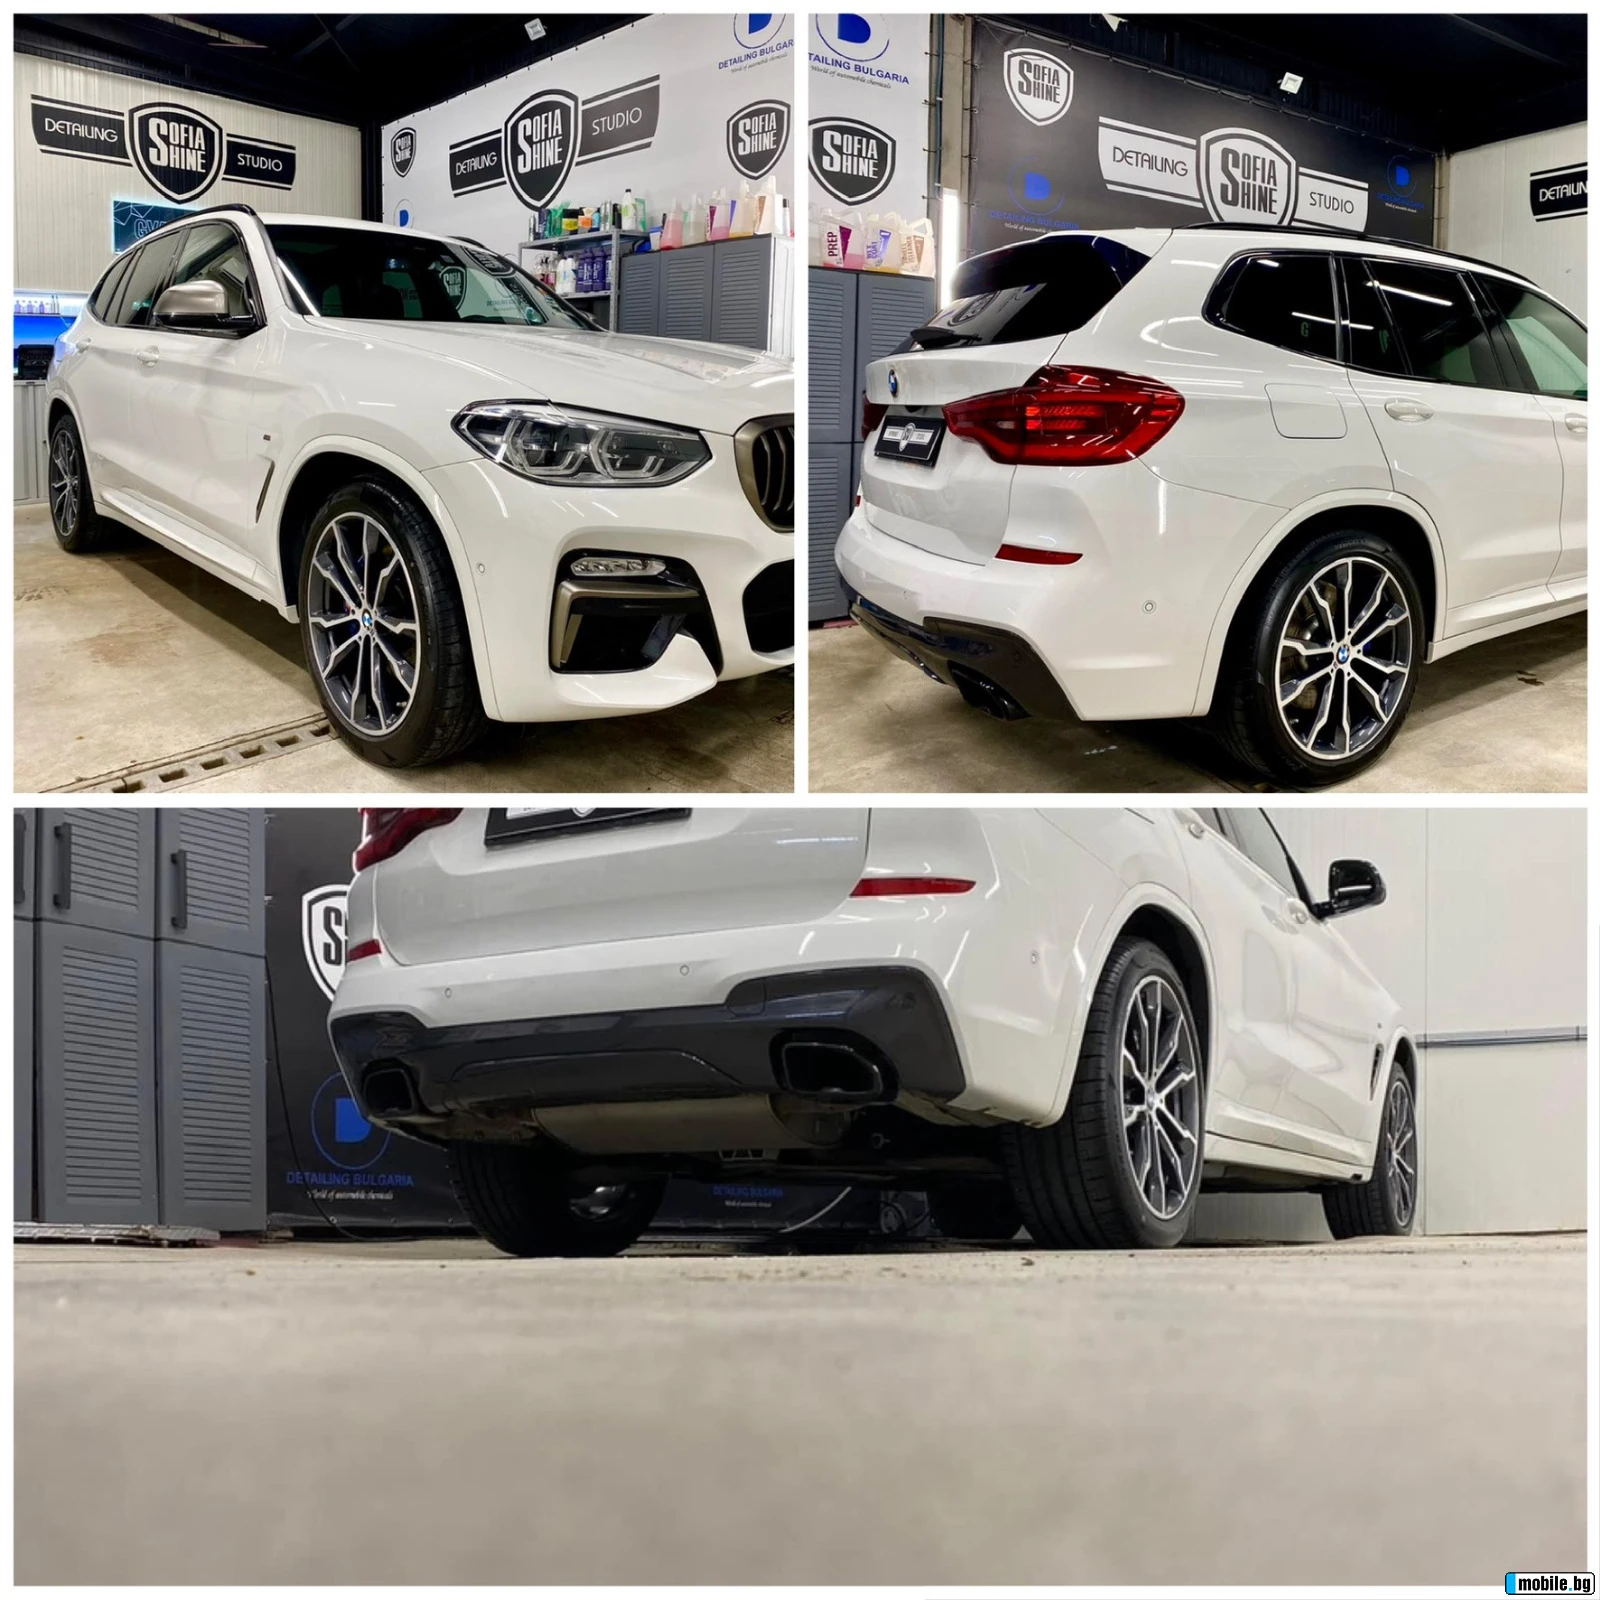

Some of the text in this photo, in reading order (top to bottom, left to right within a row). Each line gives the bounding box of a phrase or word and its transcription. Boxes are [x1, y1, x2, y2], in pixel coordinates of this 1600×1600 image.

[718, 51, 758, 70] DETAILING
[808, 52, 910, 84] TAILING BULGARIA
[1018, 59, 1060, 86] SOFIA
[45, 118, 118, 143] DETAILING
[149, 117, 205, 150] SOFIA
[517, 109, 562, 143] SOFIA
[592, 107, 642, 136] STUDIO
[737, 111, 777, 136] SOFIA
[822, 130, 878, 158] SOFIA
[237, 153, 283, 172] STUDIO
[455, 151, 498, 176] DETAILING
[1113, 146, 1188, 178] DETAILING
[1220, 147, 1277, 185] SOFIA
[1309, 191, 1354, 215] STUDIO
[827, 231, 838, 257] PREP
[287, 1171, 414, 1187] DETAILING BULGARIA
